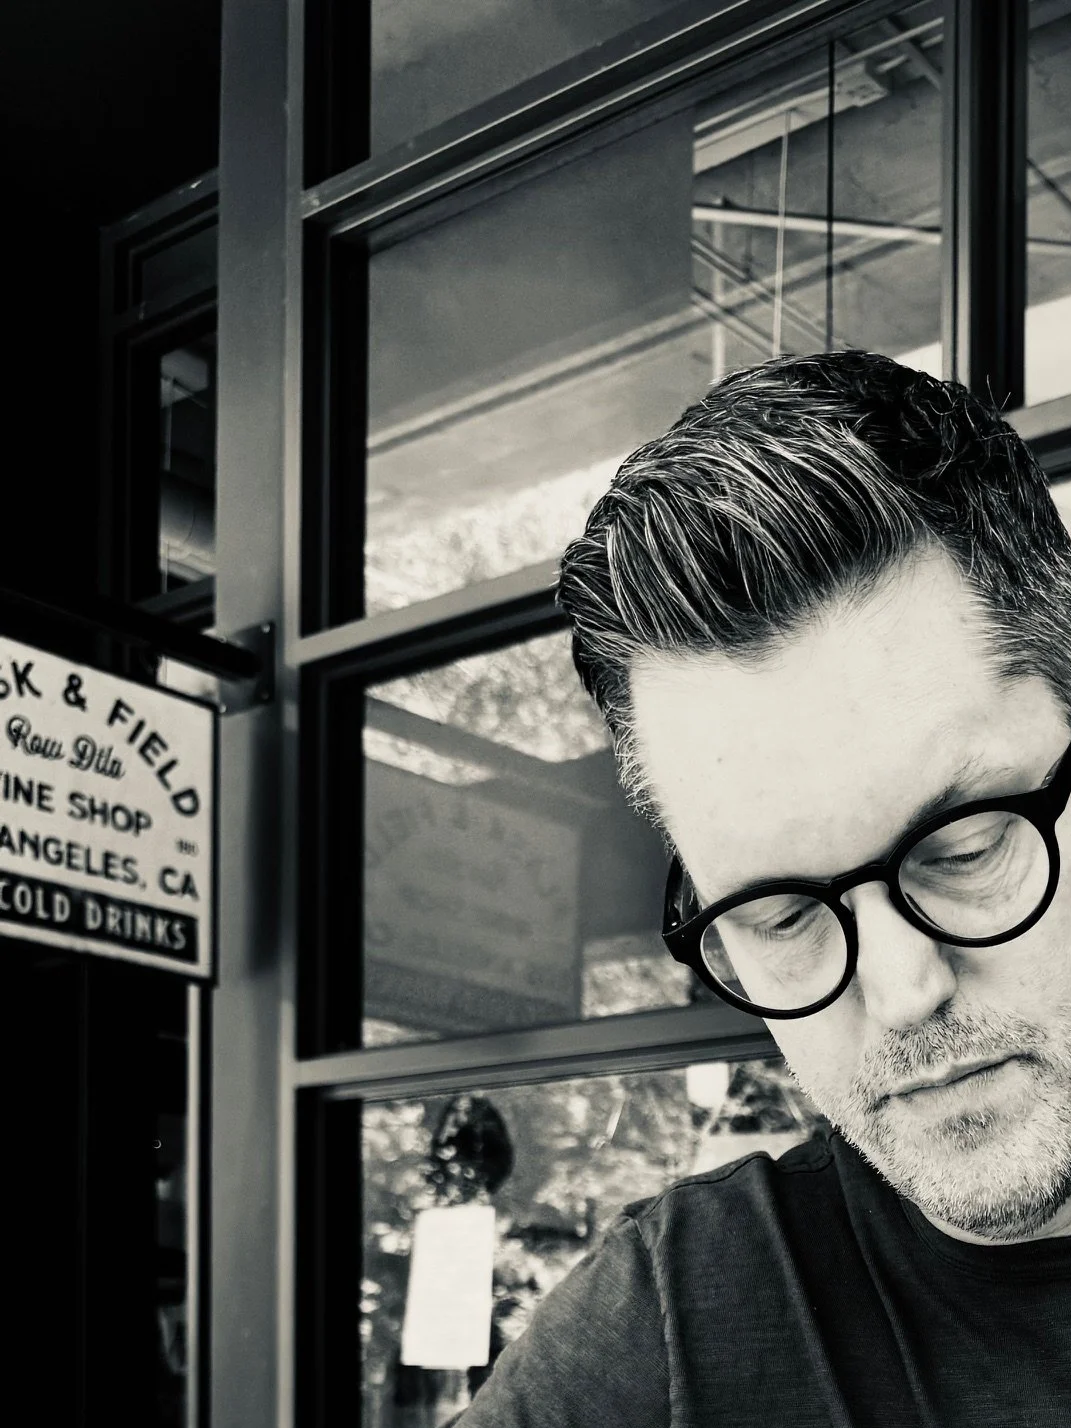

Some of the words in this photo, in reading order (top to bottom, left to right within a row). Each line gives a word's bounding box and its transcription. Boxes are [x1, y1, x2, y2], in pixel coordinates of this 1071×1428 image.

[6, 715, 65, 760] Row
[68, 735, 126, 780] Dtla
[63, 674, 86, 712] &
[107, 699, 200, 817] FIELD
[0, 771, 54, 813] INE
[68, 792, 152, 836] SHOP
[0, 824, 147, 891] ANGELES,
[158, 867, 199, 901] CA
[0, 880, 71, 924] COLD
[85, 898, 187, 950] DRINKS
